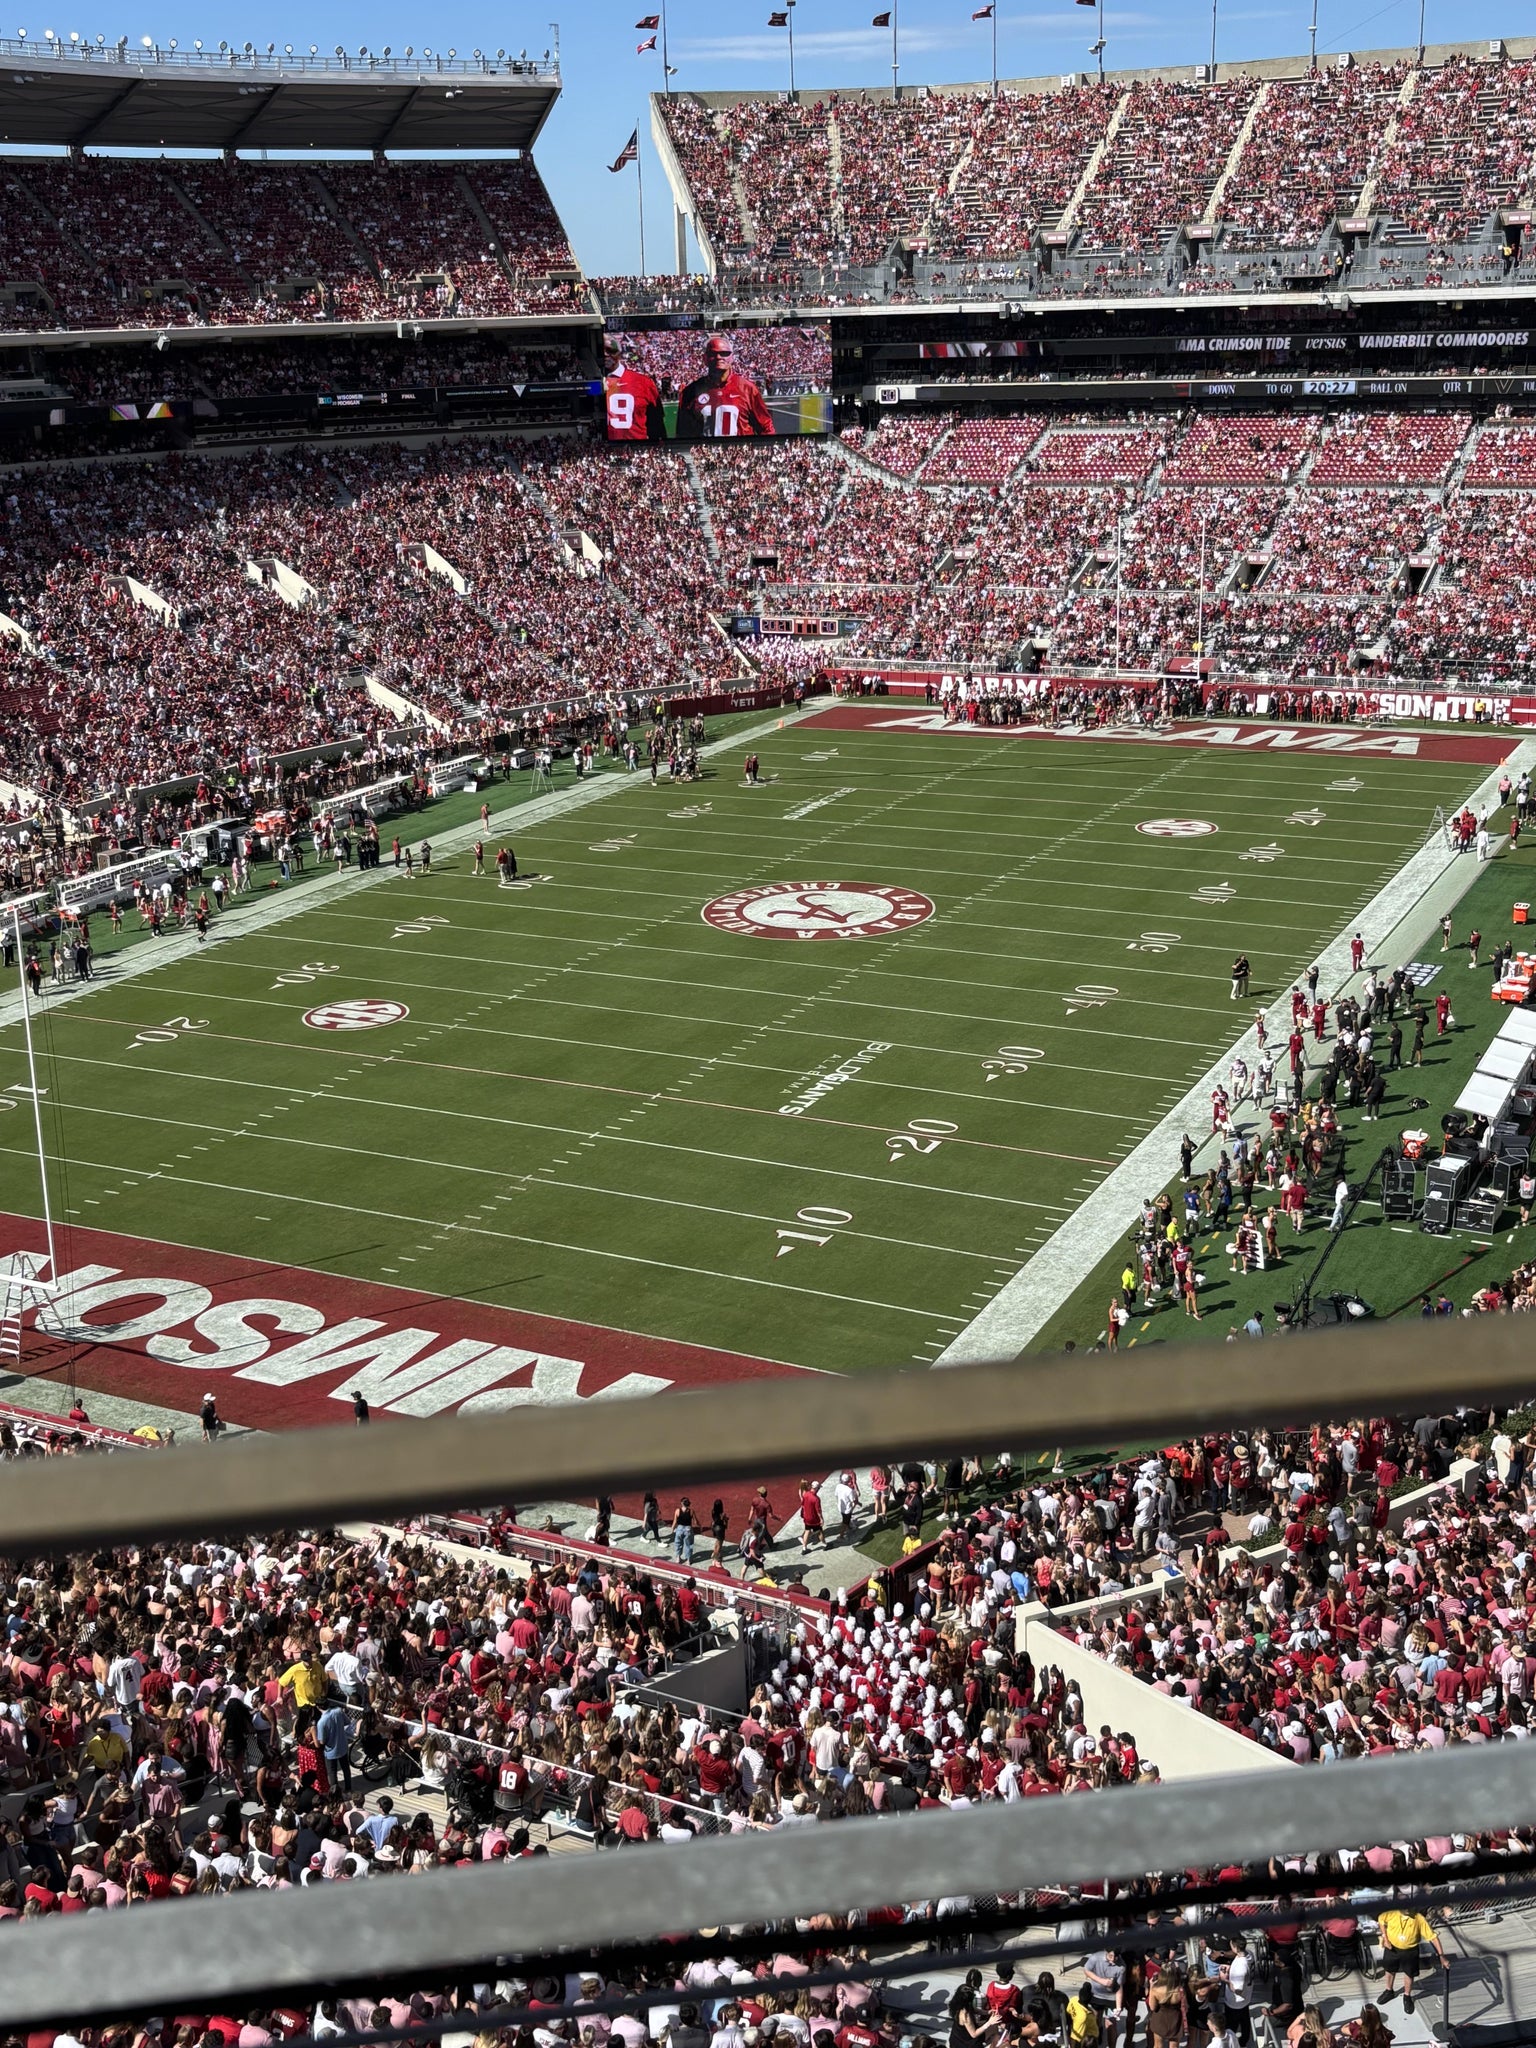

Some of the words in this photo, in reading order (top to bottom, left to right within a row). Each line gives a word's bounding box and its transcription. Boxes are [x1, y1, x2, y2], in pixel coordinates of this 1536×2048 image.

[1175, 338, 1206, 352] AMA
[1208, 337, 1263, 351] CRIMSON
[1265, 337, 1292, 350] TIDE
[1305, 337, 1347, 349] versus
[1359, 334, 1434, 349] VANDERBILT
[1436, 331, 1530, 348] COMMODORES
[881, 389, 897, 401] 40
[1208, 384, 1236, 395] DOWN
[1265, 384, 1278, 394] TO
[1280, 384, 1293, 394] GO
[1309, 381, 1350, 394] 20:27
[1370, 383, 1393, 393] BALL
[1394, 382, 1408, 393] ON
[1443, 381, 1461, 393] QTR
[1466, 380, 1473, 393] 1
[609, 393, 635, 429] 9
[701, 404, 740, 437] 10
[732, 697, 755, 707] YETI
[1324, 780, 1364, 792] 10
[1284, 811, 1326, 826] 20
[1238, 846, 1285, 862] 30
[711, 882, 841, 911] CRIMSON
[1189, 886, 1237, 904] 40
[796, 886, 926, 939] ALABAMA
[394, 915, 450, 934] 40
[1125, 932, 1182, 953] 50
[276, 961, 340, 984] 30
[1061, 984, 1120, 1008] 40
[135, 1016, 211, 1043] 20
[981, 1045, 1045, 1075] 30
[779, 1053, 842, 1094] ALABAMA
[885, 1118, 959, 1154] 20
[775, 1206, 853, 1248] 10
[0, 1250, 675, 1413] RIMSON
[1425, 1546, 1436, 1560] 17
[627, 1600, 642, 1616] 18
[125, 1669, 134, 1682] 4
[1284, 1664, 1293, 1677] 2
[781, 1741, 795, 1762] 10
[501, 1769, 517, 1790] 18
